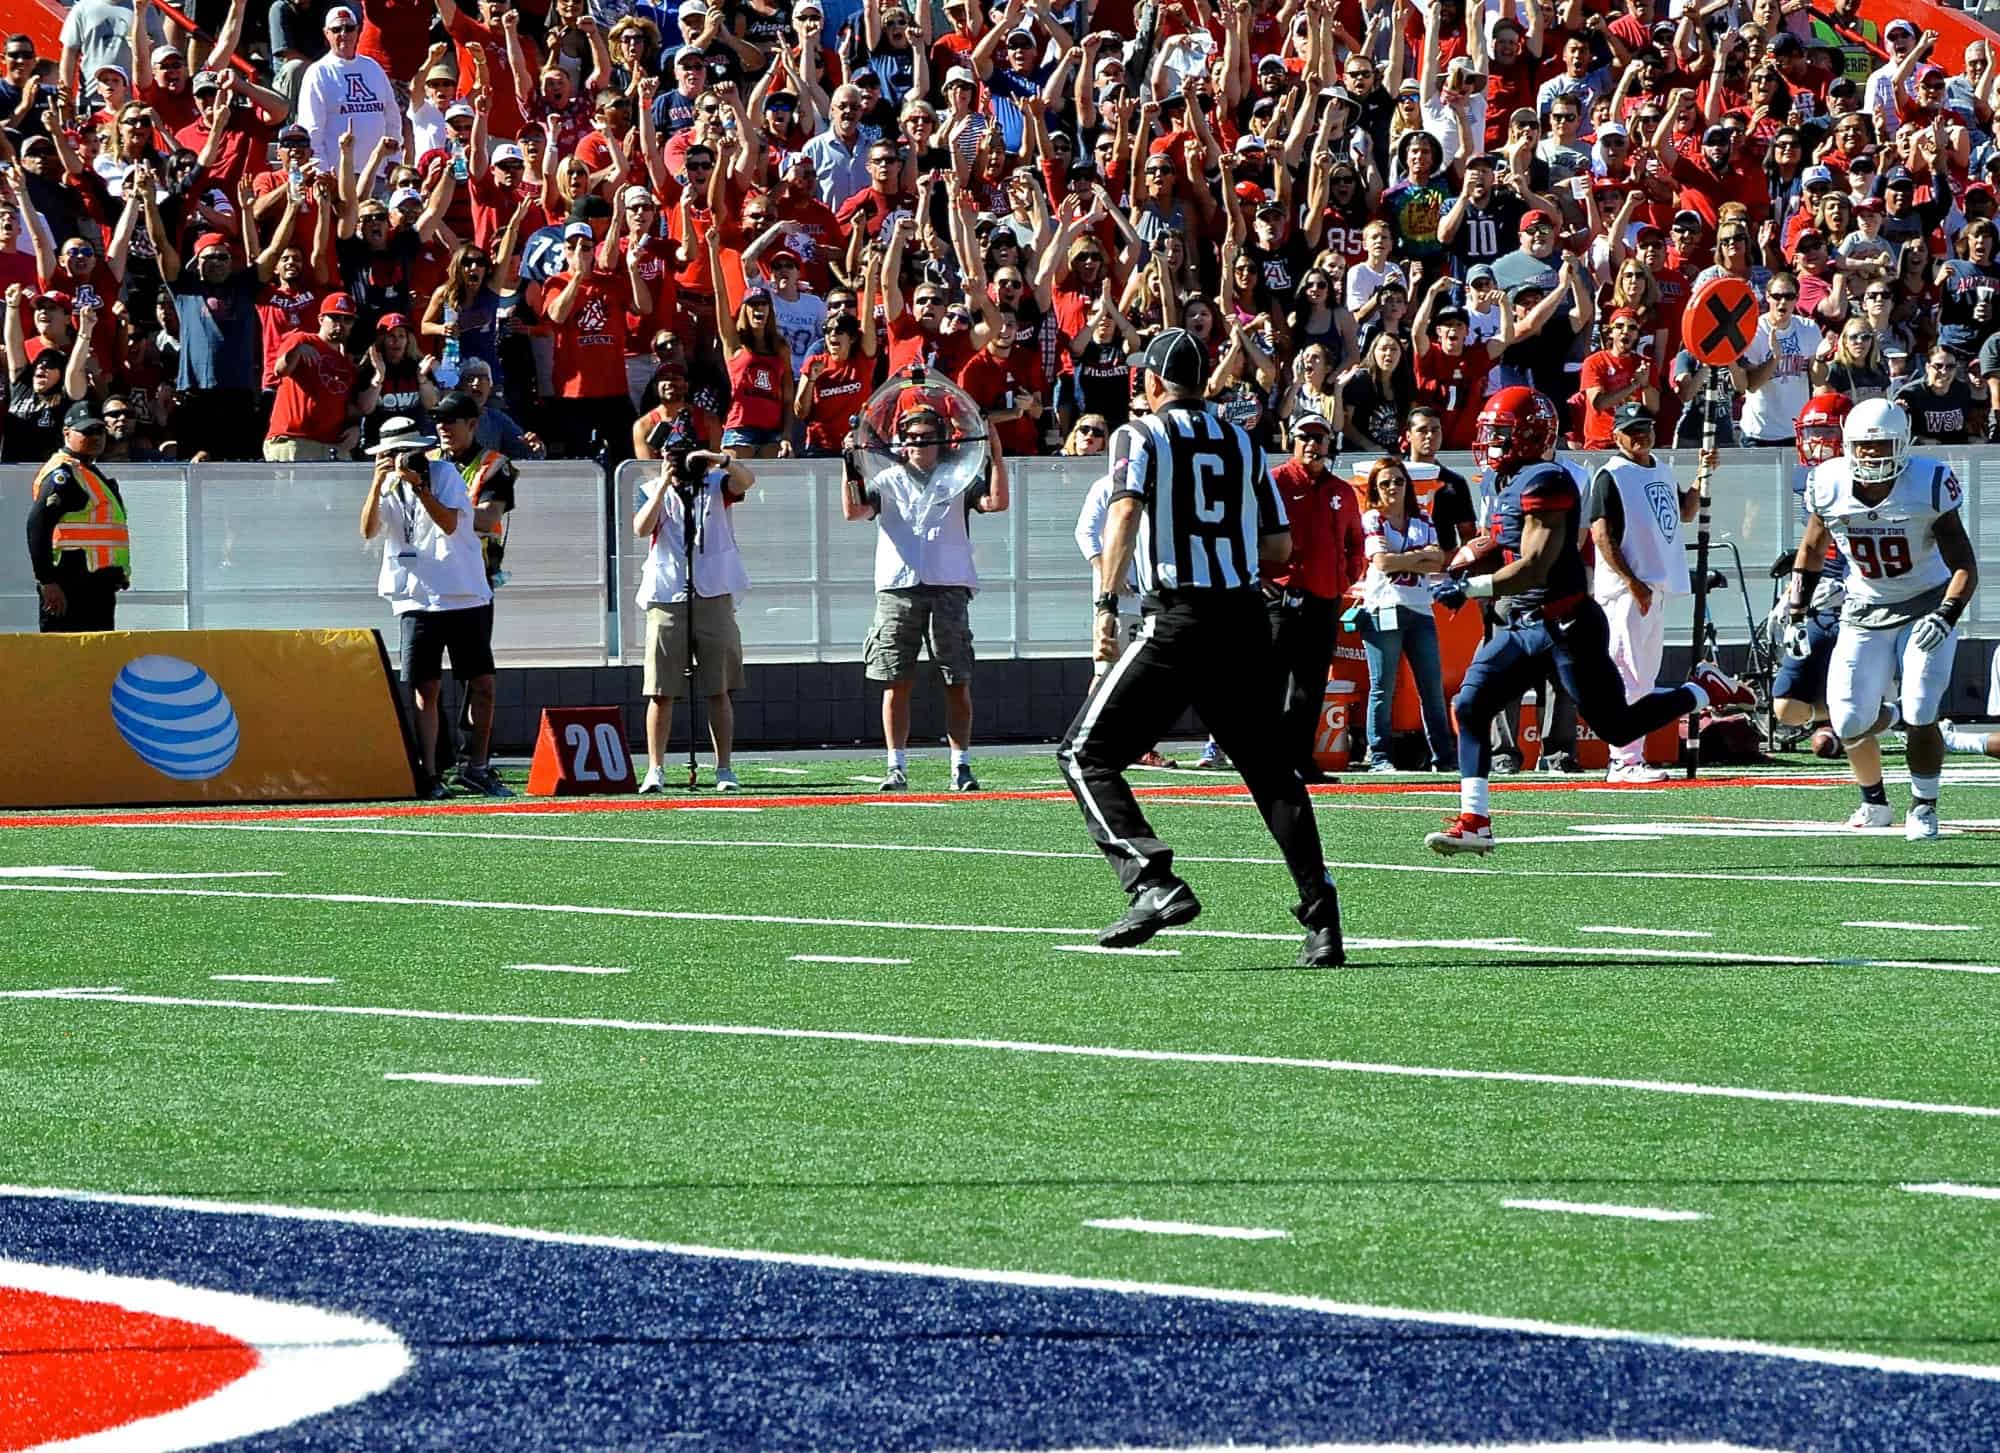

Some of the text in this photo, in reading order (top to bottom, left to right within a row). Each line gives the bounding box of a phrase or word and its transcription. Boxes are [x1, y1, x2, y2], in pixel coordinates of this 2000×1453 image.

[344, 73, 376, 103] A
[339, 102, 384, 115] ARIZONA
[1467, 220, 1497, 256] 10
[527, 235, 567, 276] 73
[1263, 260, 1292, 290] A
[754, 369, 773, 391] A
[1005, 390, 1014, 409] 1
[1446, 385, 1458, 411] 1
[1191, 452, 1225, 523] C
[1847, 535, 1914, 580] 99
[1326, 705, 1345, 729] G
[564, 722, 628, 782] 20
